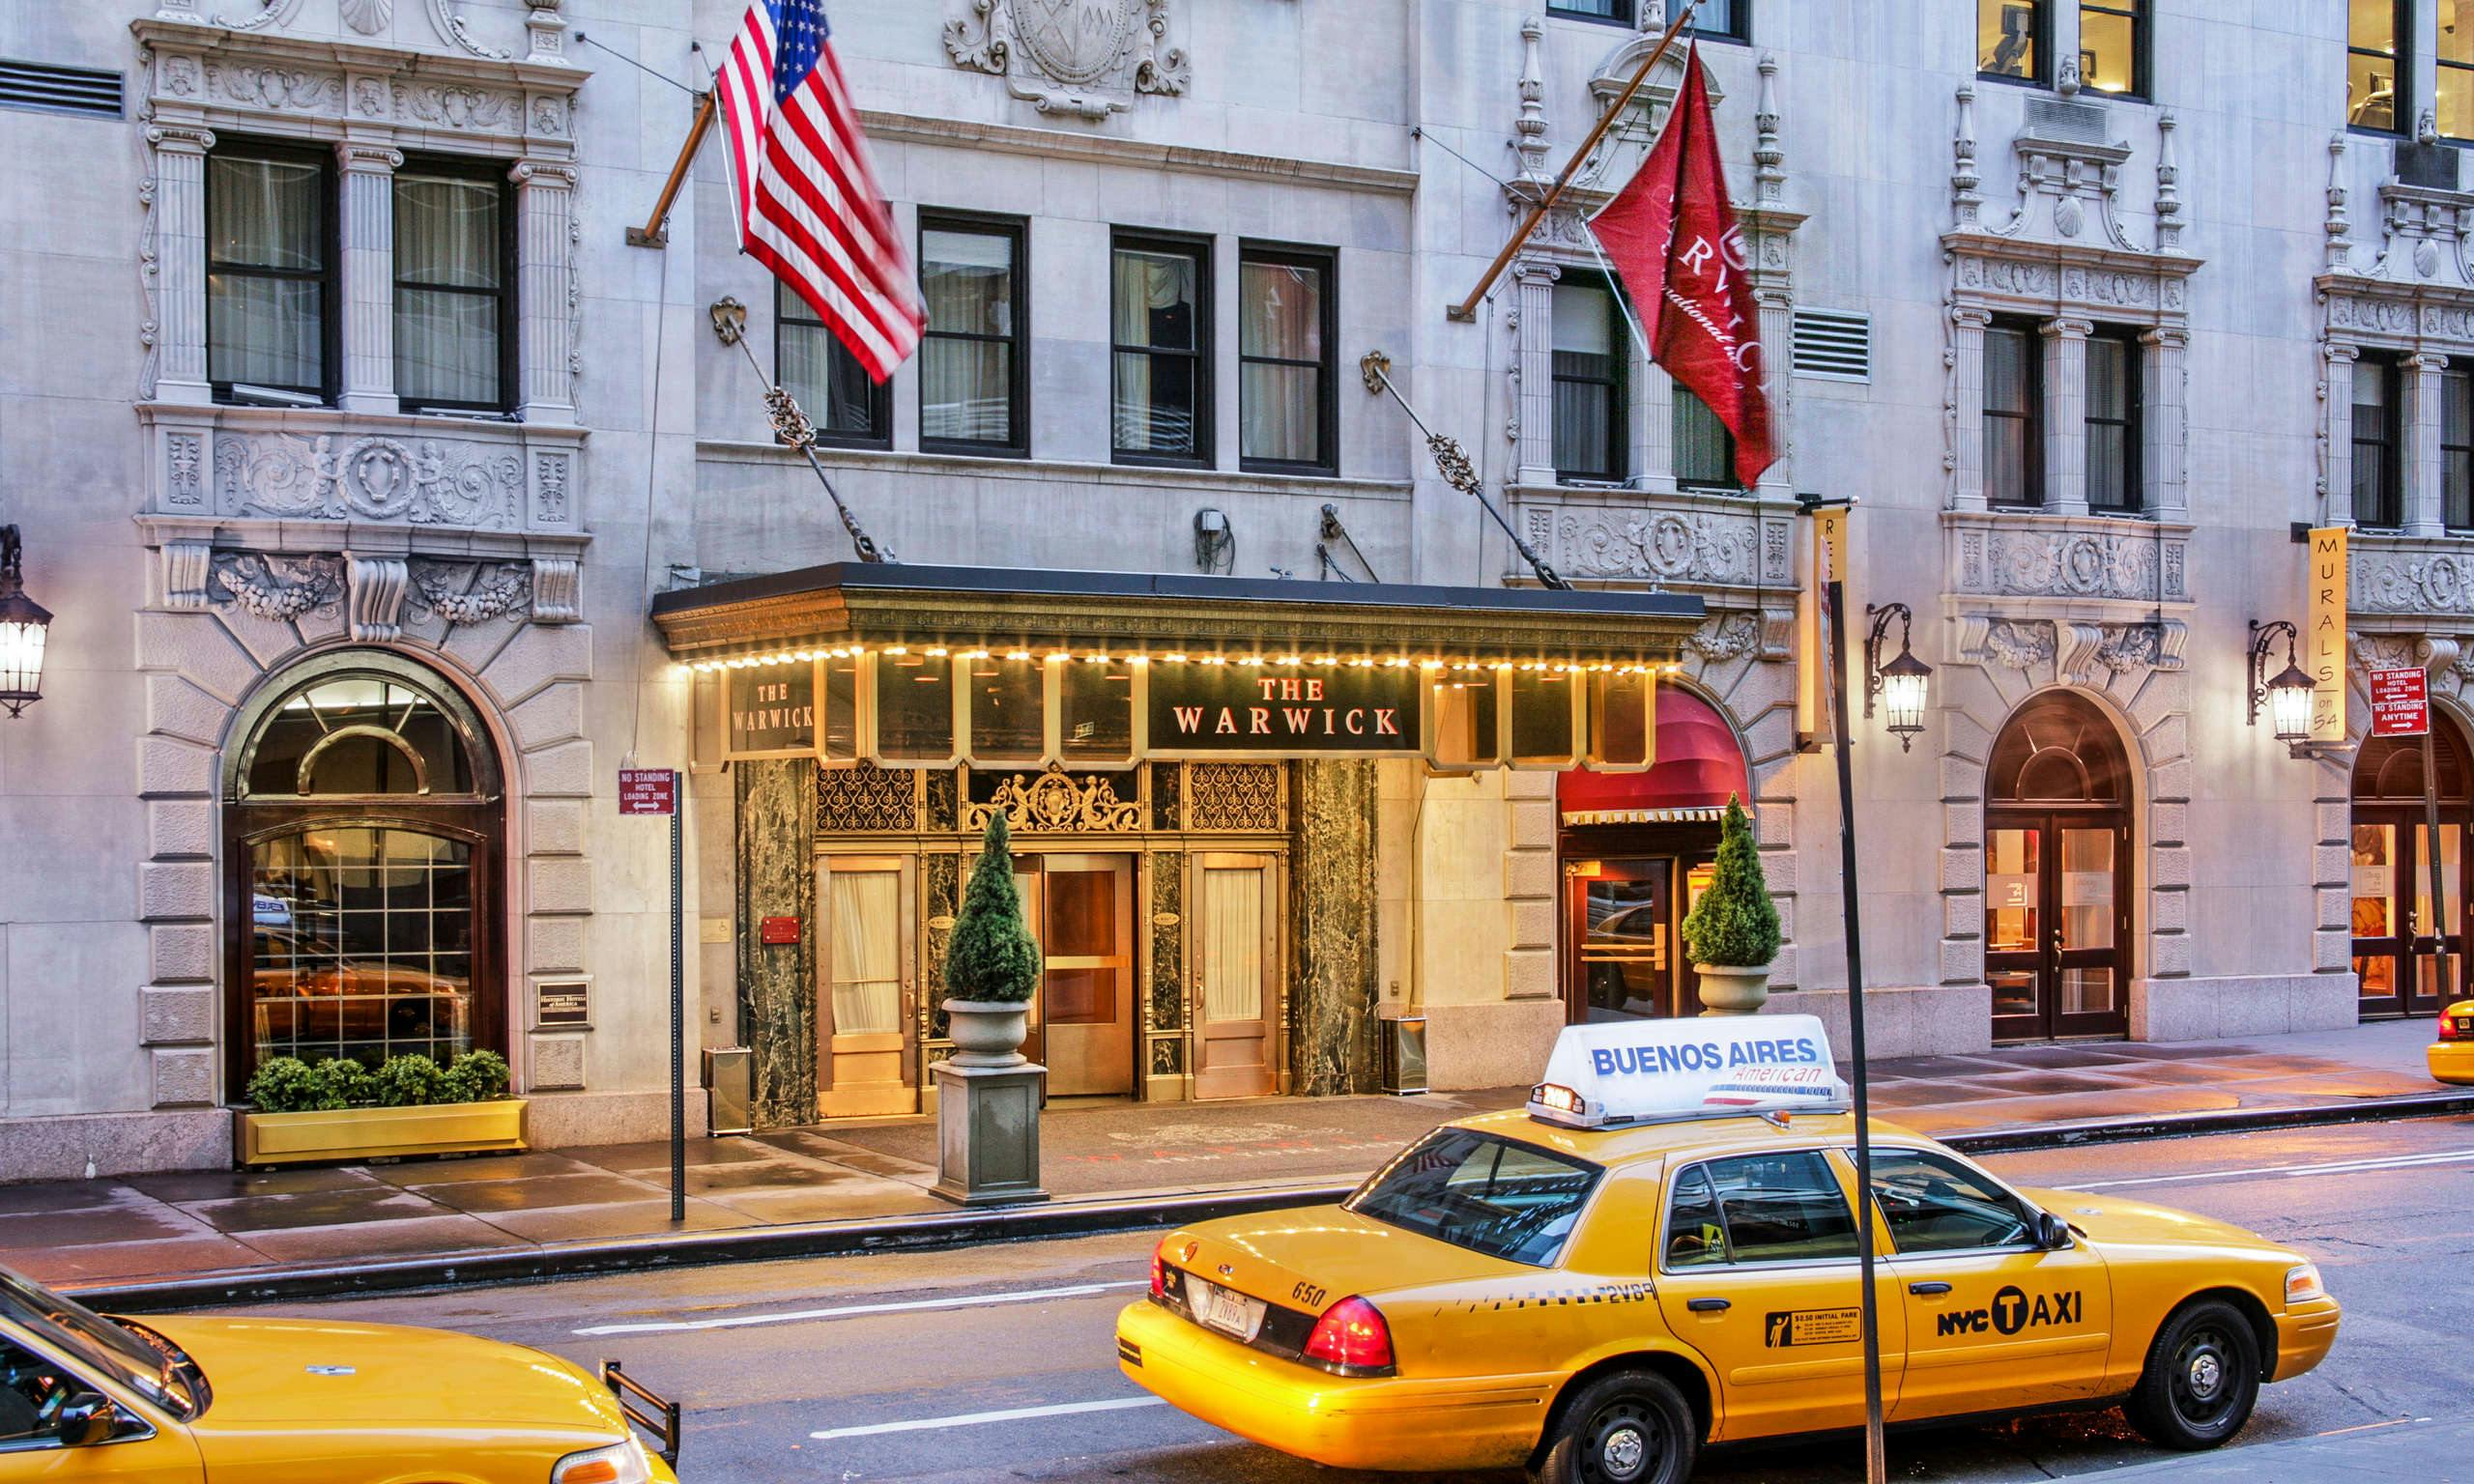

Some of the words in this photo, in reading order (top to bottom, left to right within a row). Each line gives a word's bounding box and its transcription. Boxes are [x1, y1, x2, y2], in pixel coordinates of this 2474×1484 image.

[2317, 539, 2339, 682] MURALS
[2386, 671, 2422, 680] STANDING
[758, 683, 788, 702] THE
[1257, 678, 1323, 701] THE
[2318, 697, 2333, 708] on
[2389, 702, 2424, 712] STANDING
[734, 706, 814, 730] WARWICK
[1172, 706, 1399, 735] WARWICK
[2314, 713, 2338, 731] 54
[2381, 712, 2419, 722] ANYTIME
[621, 773, 632, 783] NO
[635, 773, 671, 783] STANDING
[1592, 1042, 1723, 1076] BUENOS
[1728, 1038, 1817, 1068] AIRES
[1733, 1066, 1822, 1083] American
[1292, 1281, 1326, 1307] 650
[1606, 1282, 1657, 1303] 2V89
[1937, 1308, 1989, 1336] NYC
[1993, 1288, 2082, 1332] TAXI
